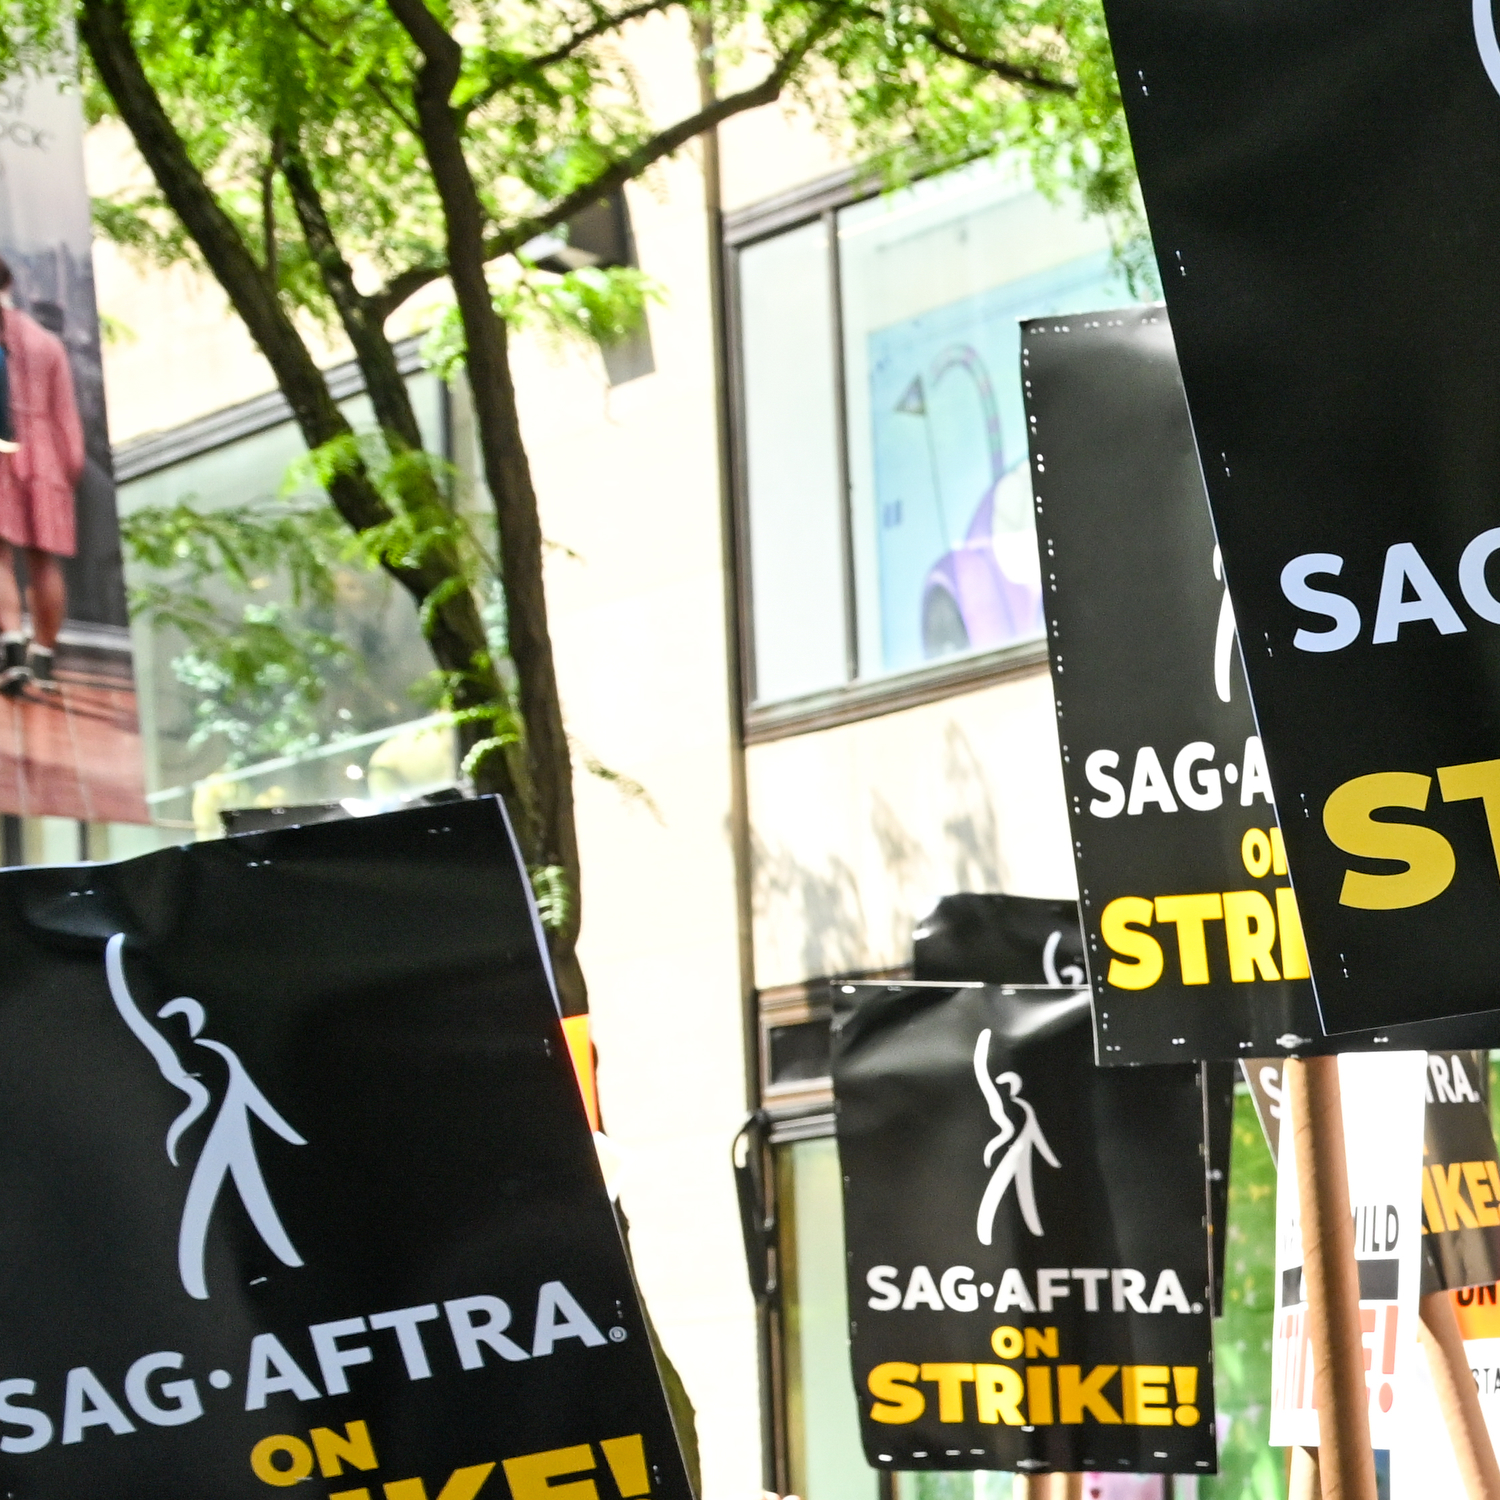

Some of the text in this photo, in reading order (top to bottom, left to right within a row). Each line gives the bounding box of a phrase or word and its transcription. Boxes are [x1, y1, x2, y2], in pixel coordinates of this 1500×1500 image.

[1353, 1204, 1399, 1252] ILD
[991, 1326, 1059, 1359] ON
[867, 1361, 1201, 1427] STRIKE!
[251, 1420, 377, 1487] ON
